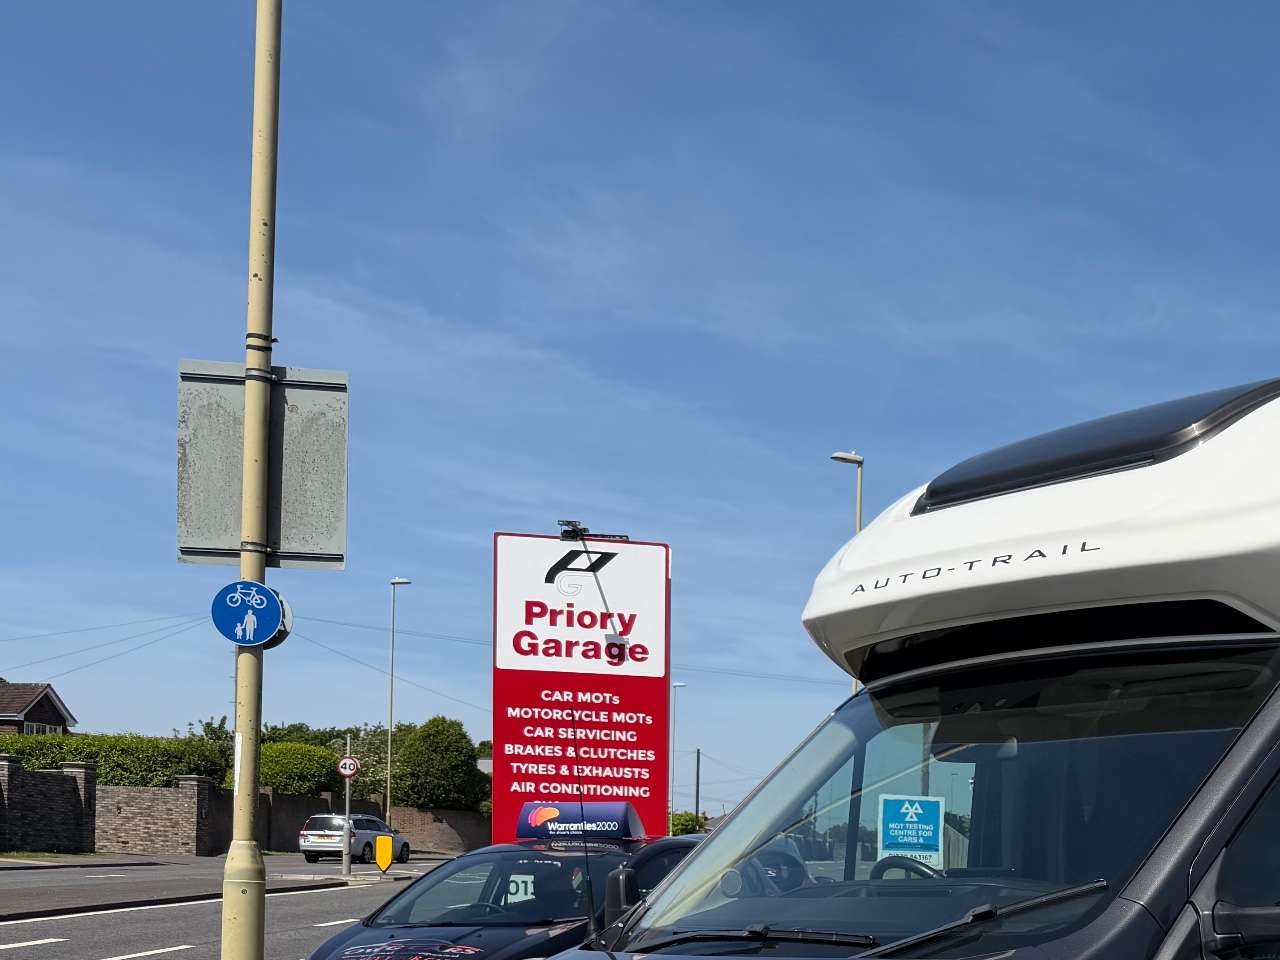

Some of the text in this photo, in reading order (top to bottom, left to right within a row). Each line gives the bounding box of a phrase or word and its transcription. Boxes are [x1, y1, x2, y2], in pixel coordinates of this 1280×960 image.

[851, 541, 1100, 595] AUTO-TRAIL
[525, 600, 637, 637] Priory
[512, 630, 649, 666] Garage
[541, 690, 620, 705] CAR MOTs
[507, 707, 653, 725] MOTORCYCLE MOTs
[523, 726, 638, 742] CAR SERVICING
[504, 744, 656, 761] BRAKES & CLUTCHES
[340, 763, 356, 771] 40
[510, 762, 650, 779] TYRES & EXHAUSTS
[510, 782, 650, 797] AIR CONDITIONING
[547, 821, 618, 831] Warranties2000
